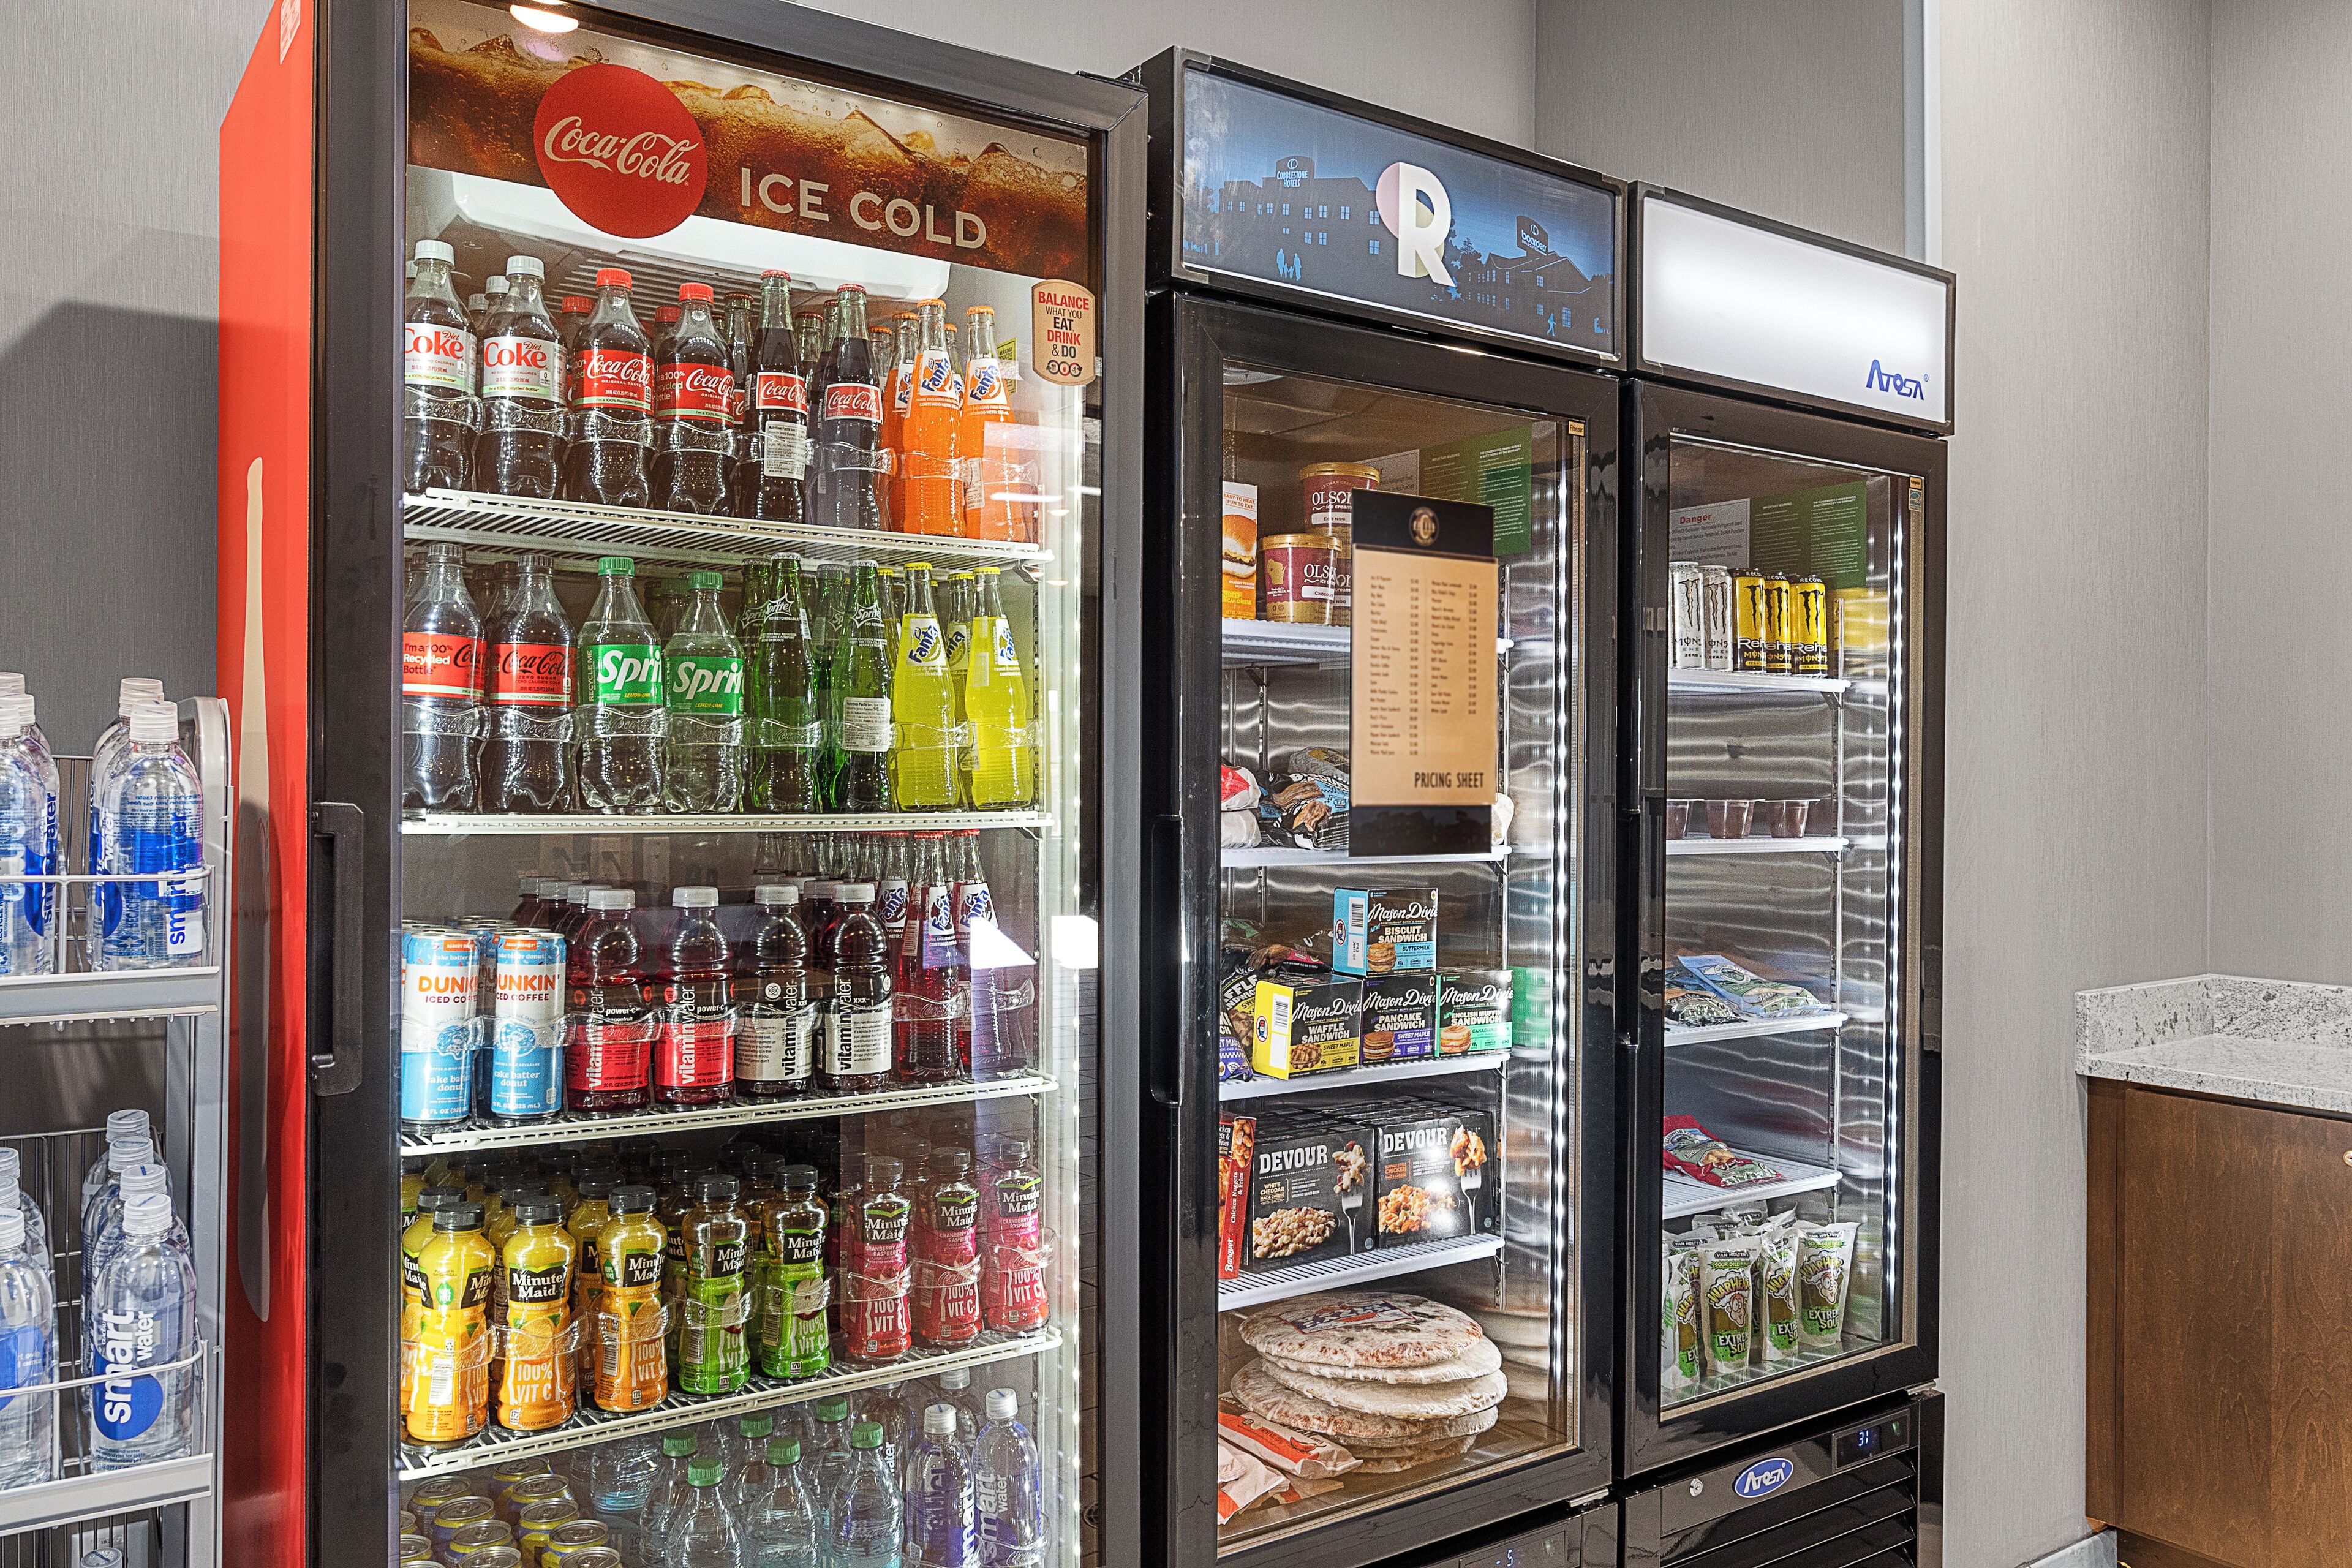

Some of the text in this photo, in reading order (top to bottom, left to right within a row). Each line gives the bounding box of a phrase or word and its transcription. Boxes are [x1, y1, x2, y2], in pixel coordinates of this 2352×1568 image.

[544, 116, 699, 185] Coca-Cola
[1276, 170, 1308, 179] COBBLESTONE
[742, 167, 987, 249] ICE COLD
[1398, 161, 1457, 288] R
[1521, 229, 1547, 252] boarders
[1038, 291, 1089, 311] BALANCE
[1046, 306, 1082, 319] WHAT YOU
[442, 330, 460, 341] Diet
[1047, 329, 1081, 345] DRINK
[405, 328, 464, 360] Coke
[524, 341, 542, 350] Diet
[1052, 344, 1076, 358] & DO
[484, 342, 548, 369] Coke
[587, 354, 651, 385] Coca-Cola
[665, 371, 685, 380] 100%
[921, 358, 950, 392] Fanta
[686, 369, 734, 399] Coca-Col
[970, 364, 1000, 401] Fanta
[761, 380, 807, 407] Coca-Cola
[827, 391, 877, 412] Coca-Cola
[1569, 424, 1583, 433] Freezer
[1679, 513, 1713, 525] Danger
[767, 601, 790, 613] Sprite
[908, 625, 938, 663] Fanta
[1792, 642, 1827, 654] Reha
[587, 650, 593, 661] ME
[597, 650, 662, 690] Spri
[673, 660, 745, 699] Sprit
[1414, 772, 1484, 788] PRICING SHEET
[105, 809, 115, 863] water
[1368, 902, 1438, 922] Mason Dixie
[1385, 925, 1422, 935] BISCUIT
[1378, 933, 1427, 944] SANDWICH
[418, 975, 478, 993] DUNKI
[497, 974, 560, 992] UNKIN'
[426, 995, 450, 1004] ICED
[511, 993, 549, 1001] COFFEE
[1363, 989, 1436, 1011] Mason Dixie
[1440, 984, 1513, 1005] Mason Dixie
[606, 1007, 636, 1016] power-c
[697, 1005, 725, 1014] power-c
[1292, 998, 1362, 1023] Mason Dixie
[1379, 1012, 1422, 1022] PANCAKE
[1308, 1022, 1344, 1035] WAFFLE
[1374, 1020, 1425, 1031] SANDWICH
[1452, 1016, 1502, 1026] SANDWICH
[1302, 1030, 1350, 1044] SANDWICH
[1384, 1127, 1448, 1153] DEVOUR
[1259, 1144, 1329, 1174] DEVOUR
[1385, 1166, 1407, 1175] CHICKEN
[1002, 1190, 1040, 1203] Minute
[1260, 1186, 1285, 1196] CHEDDAR
[941, 1204, 978, 1218] Minute
[1008, 1202, 1038, 1213] Maid
[866, 1214, 909, 1230] Minute
[946, 1216, 974, 1227] Maid
[788, 1234, 826, 1250] Minute
[872, 1227, 905, 1241] Maid
[793, 1246, 823, 1259] Maid
[865, 1243, 892, 1252] CRANBERRY
[1224, 1237, 1235, 1273] Banquet
[1726, 1250, 1749, 1259] HOLTEN'S
[512, 1273, 563, 1287] Minute
[1013, 1268, 1039, 1286] 100%
[518, 1286, 556, 1299] Maid
[948, 1283, 974, 1299] 100%
[1013, 1286, 1031, 1303] VIT
[948, 1301, 965, 1318] VIT
[1808, 1308, 1838, 1321] EXTRE
[799, 1320, 824, 1336] 100%
[873, 1314, 895, 1333] VIT
[137, 1310, 153, 1362] water
[1719, 1332, 1748, 1347] EXTRE
[638, 1340, 665, 1362] 100%
[798, 1337, 816, 1354] VIT
[102, 1308, 135, 1424] smart
[517, 1362, 554, 1382] 100%
[637, 1362, 655, 1382] VIT
[516, 1383, 552, 1404] VIT C
[1858, 1430, 1869, 1447] 31
